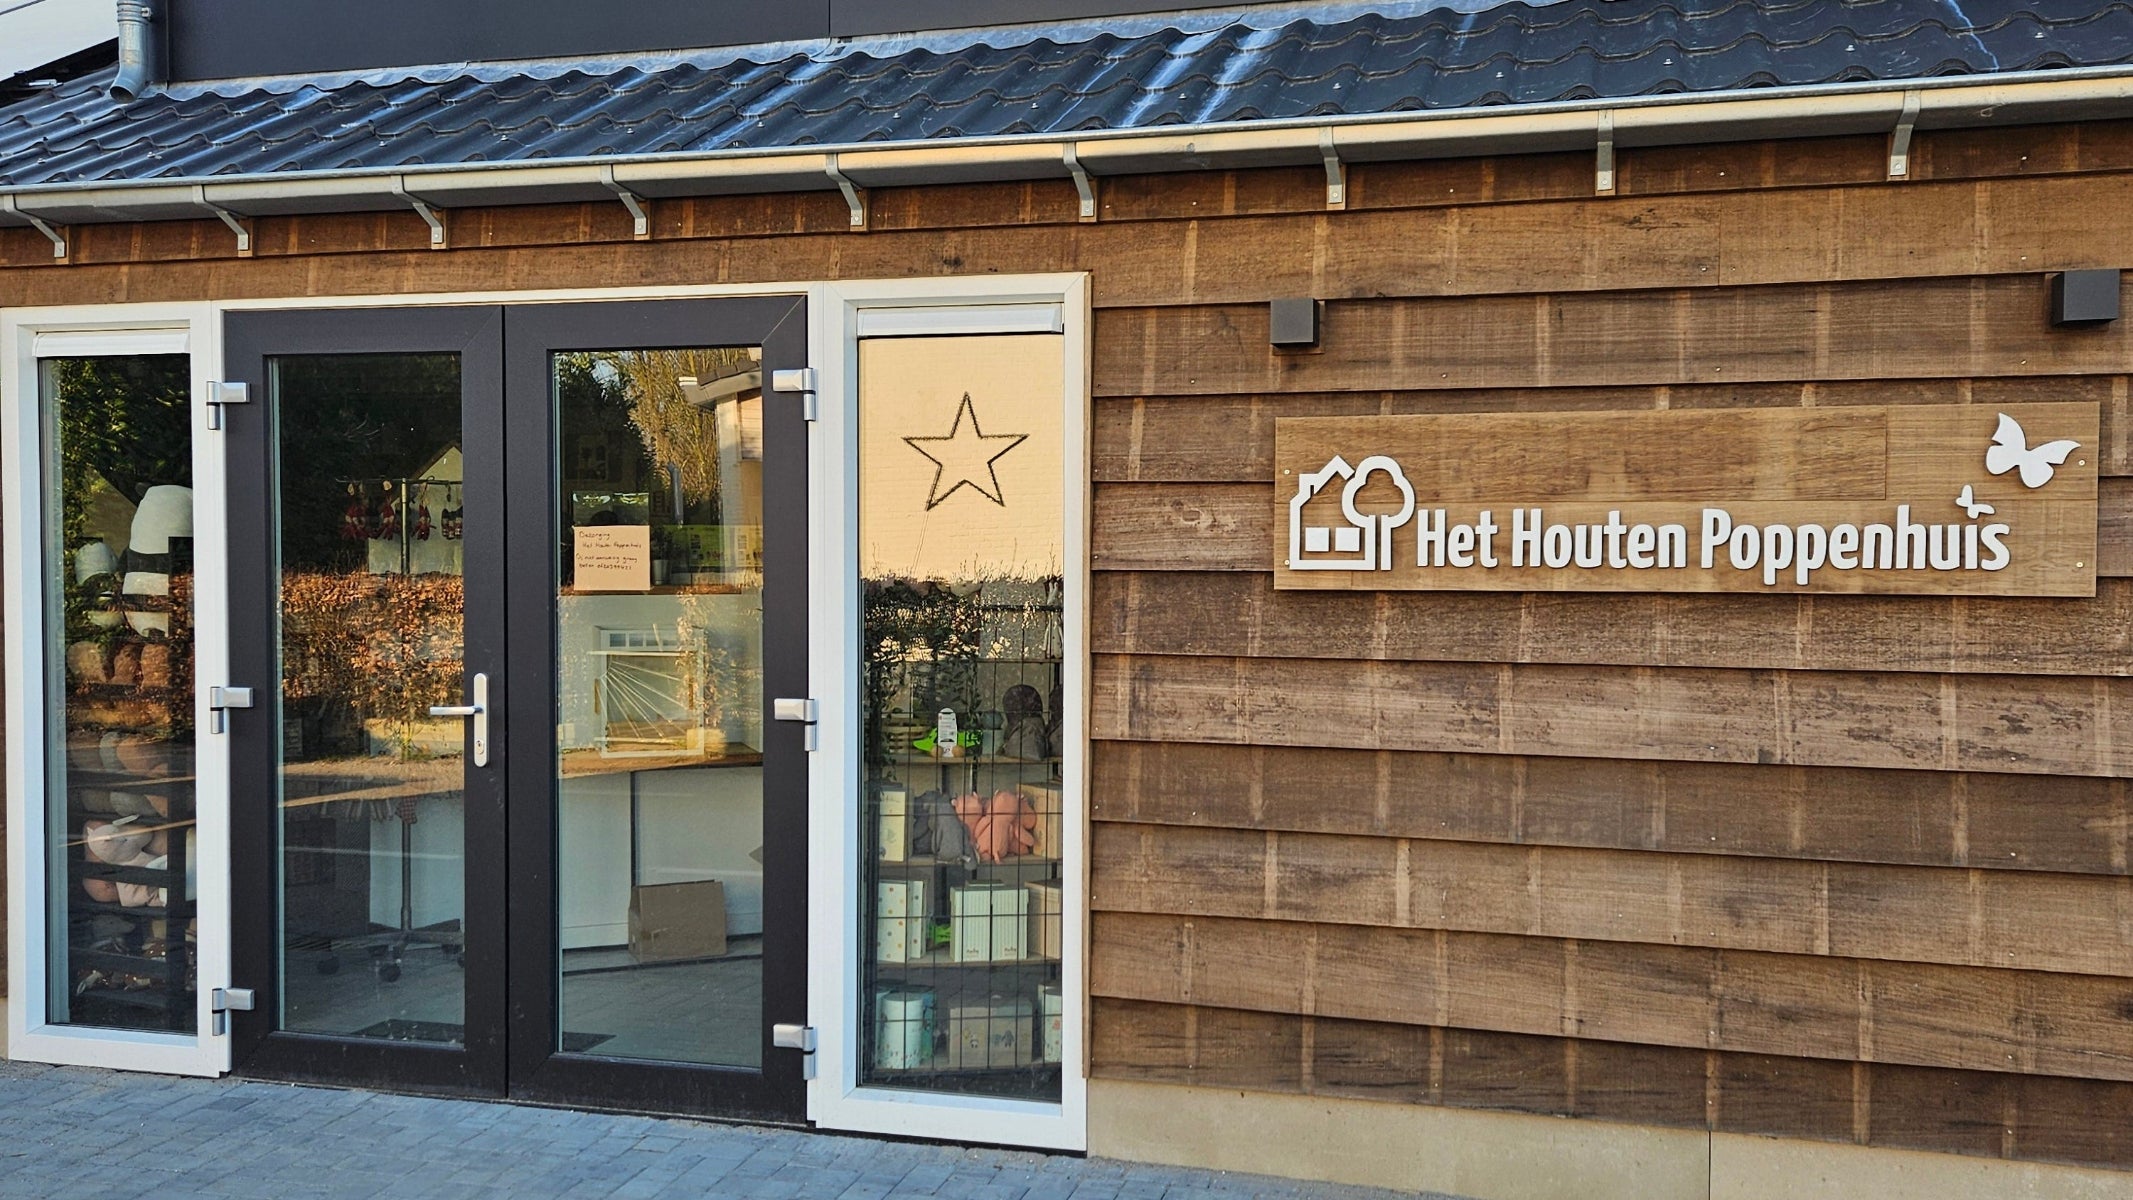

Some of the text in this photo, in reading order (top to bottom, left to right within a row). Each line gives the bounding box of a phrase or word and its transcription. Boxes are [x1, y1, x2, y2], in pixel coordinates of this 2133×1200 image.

[1417, 503, 2011, 586] Het Houten Poppenhuis
